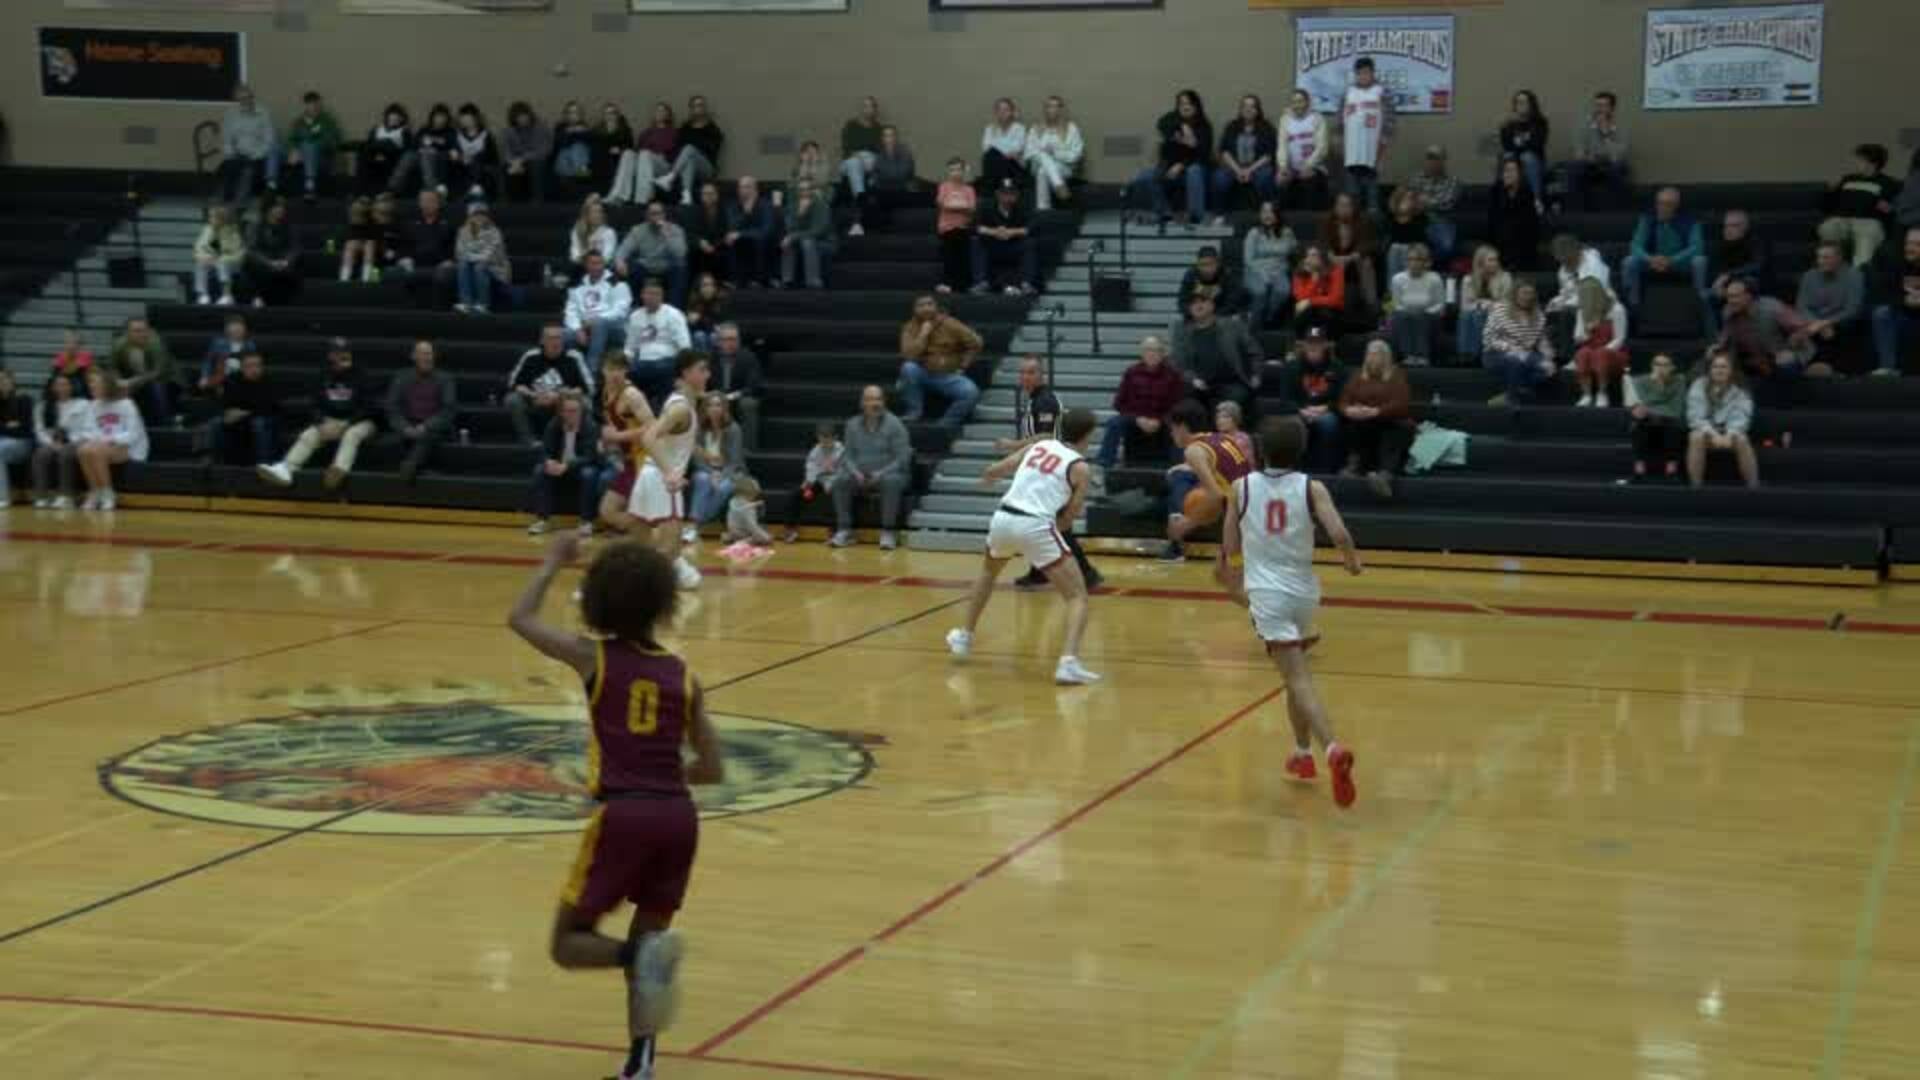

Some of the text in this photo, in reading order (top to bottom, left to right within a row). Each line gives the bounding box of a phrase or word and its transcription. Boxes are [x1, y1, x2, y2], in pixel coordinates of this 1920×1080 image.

[1300, 30, 1449, 71] STATE CHAMPIONS
[1651, 19, 1818, 66] STATE CHAMPIONS
[1027, 447, 1062, 474] 20
[1266, 500, 1287, 535] 0
[628, 680, 659, 734] 0
